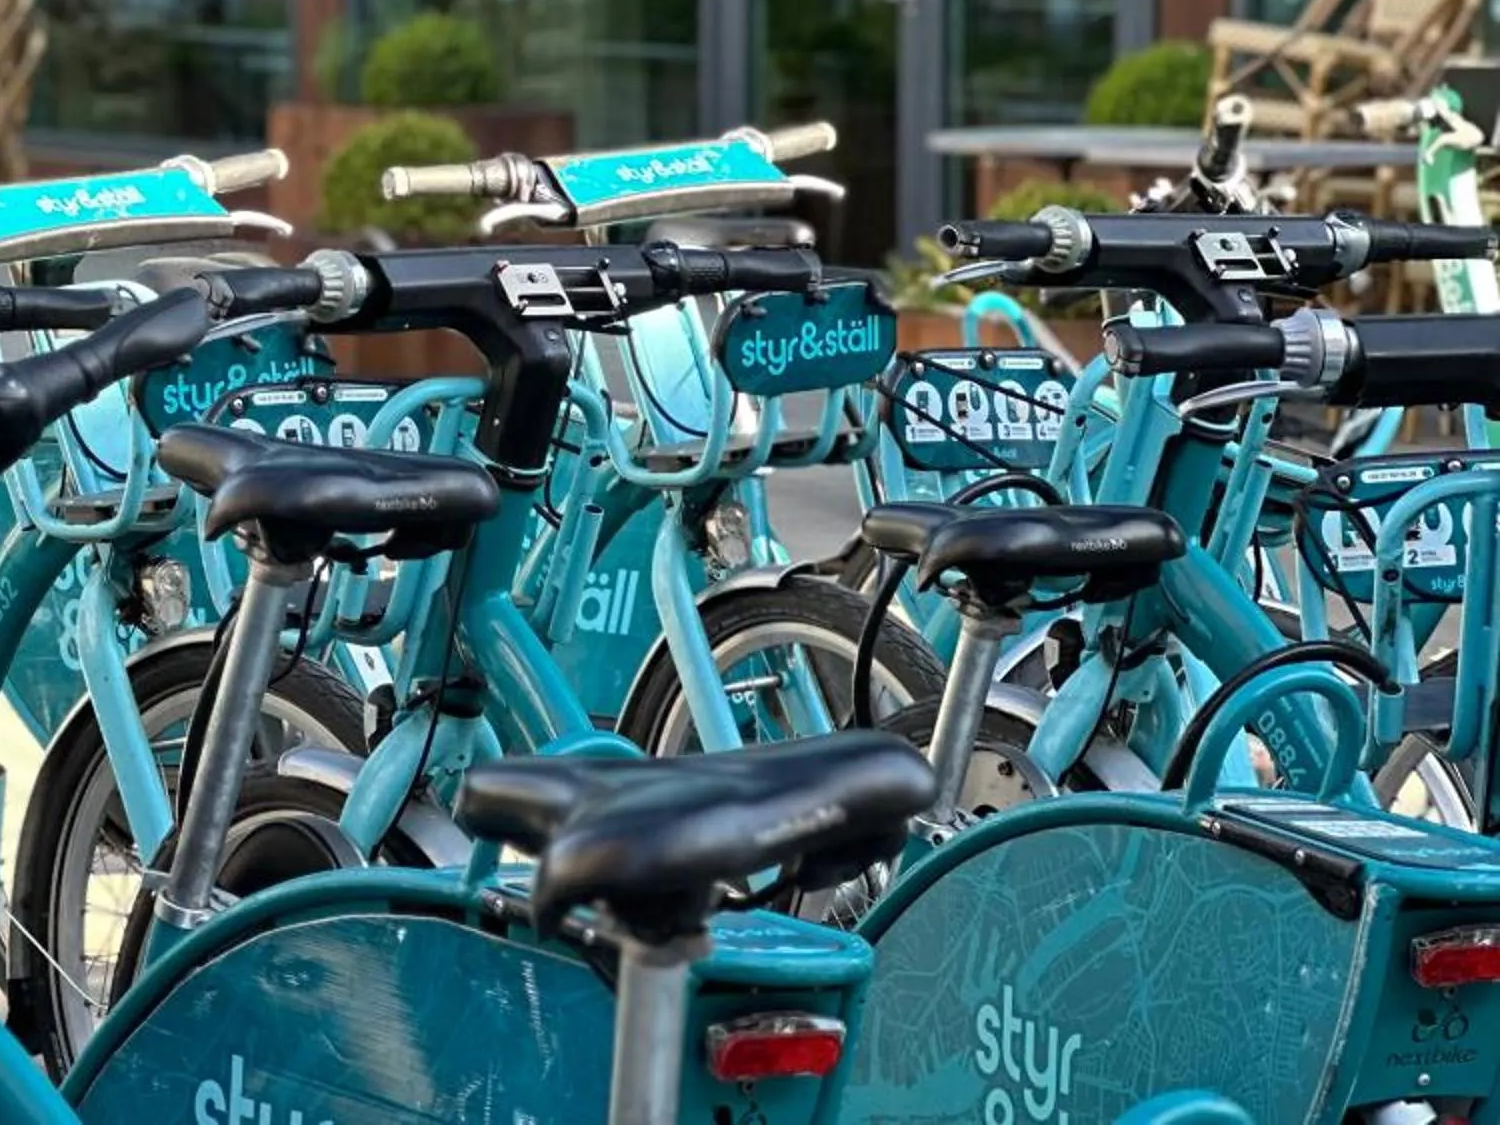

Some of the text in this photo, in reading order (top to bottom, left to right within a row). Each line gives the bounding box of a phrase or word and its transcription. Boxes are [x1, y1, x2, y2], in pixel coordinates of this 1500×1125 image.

[741, 315, 880, 376] styr&ställ
[1407, 550, 1419, 565] 2
[575, 568, 640, 635] äll
[976, 984, 1081, 1122] styr
